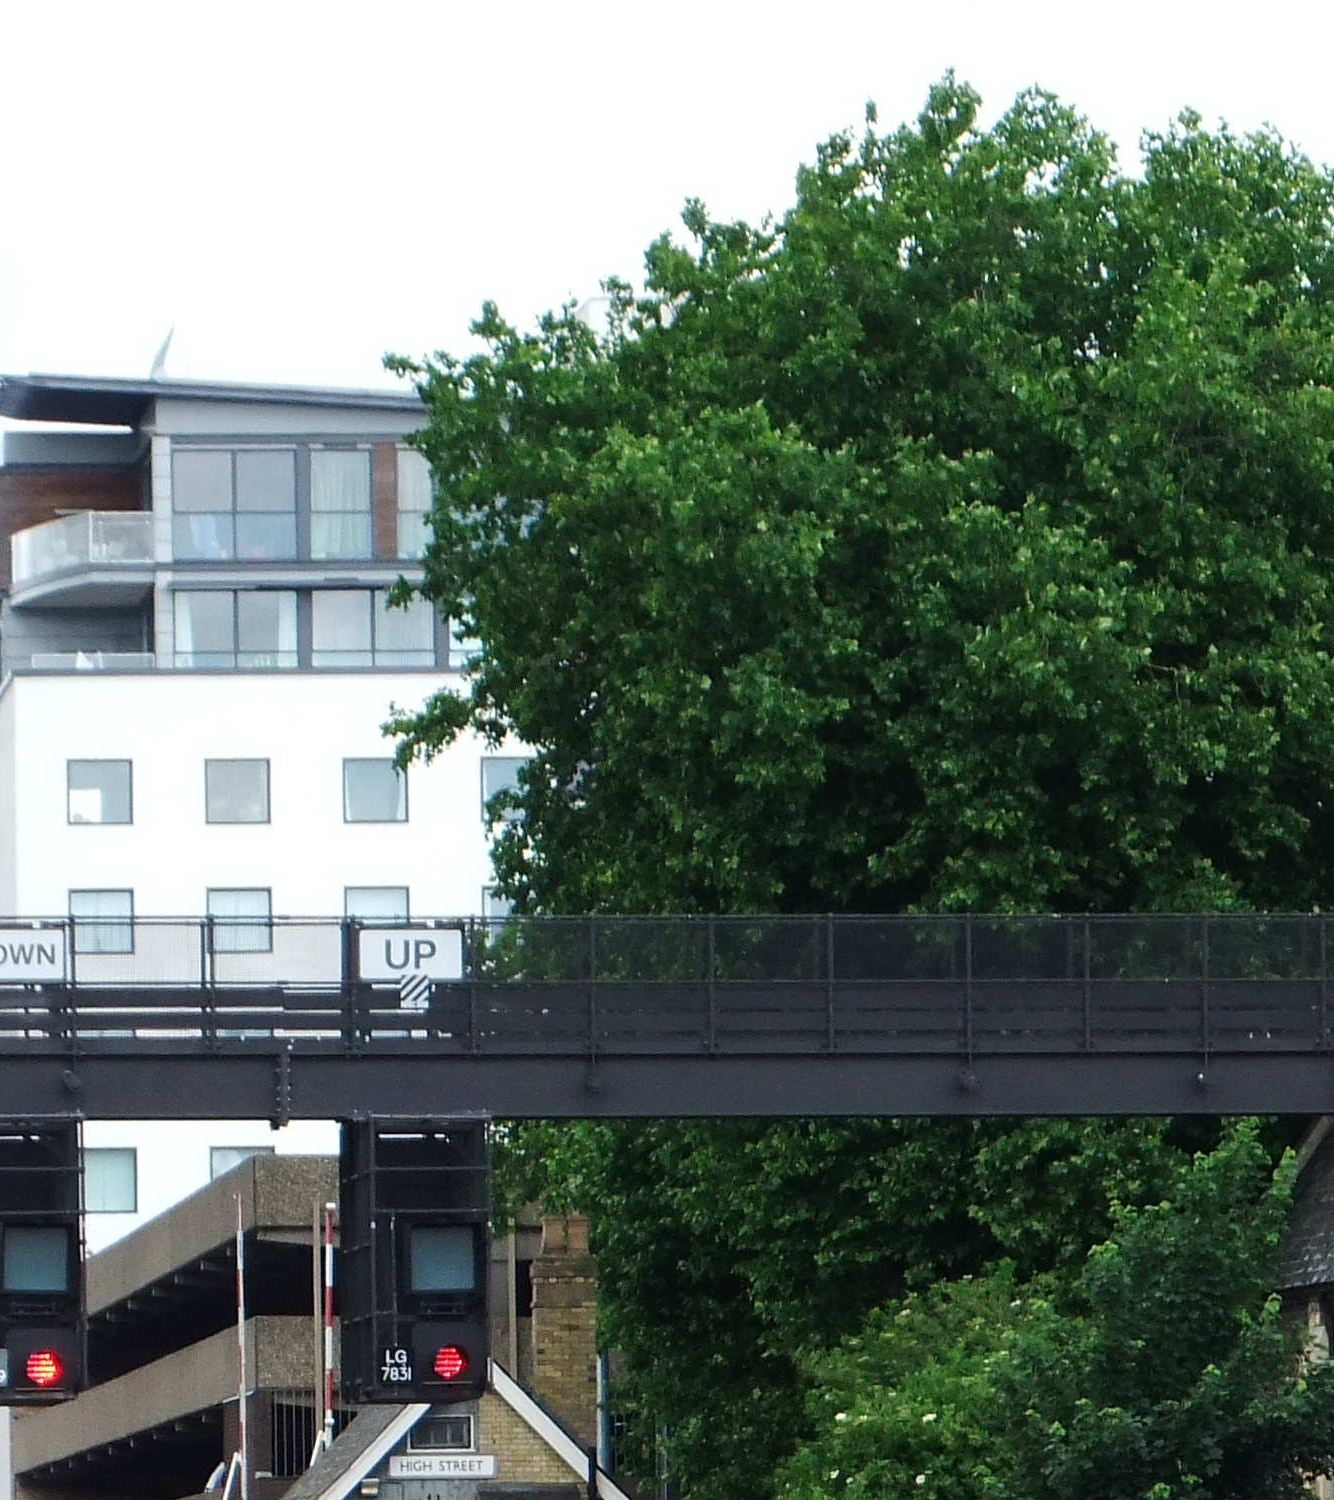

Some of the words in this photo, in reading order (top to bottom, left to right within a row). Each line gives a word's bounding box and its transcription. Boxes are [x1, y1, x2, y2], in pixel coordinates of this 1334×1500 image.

[385, 939, 437, 970] UP
[385, 1349, 408, 1364] LG
[380, 1366, 412, 1381] 7831
[400, 1460, 433, 1472] HIGH
[439, 1460, 483, 1472] STREET
